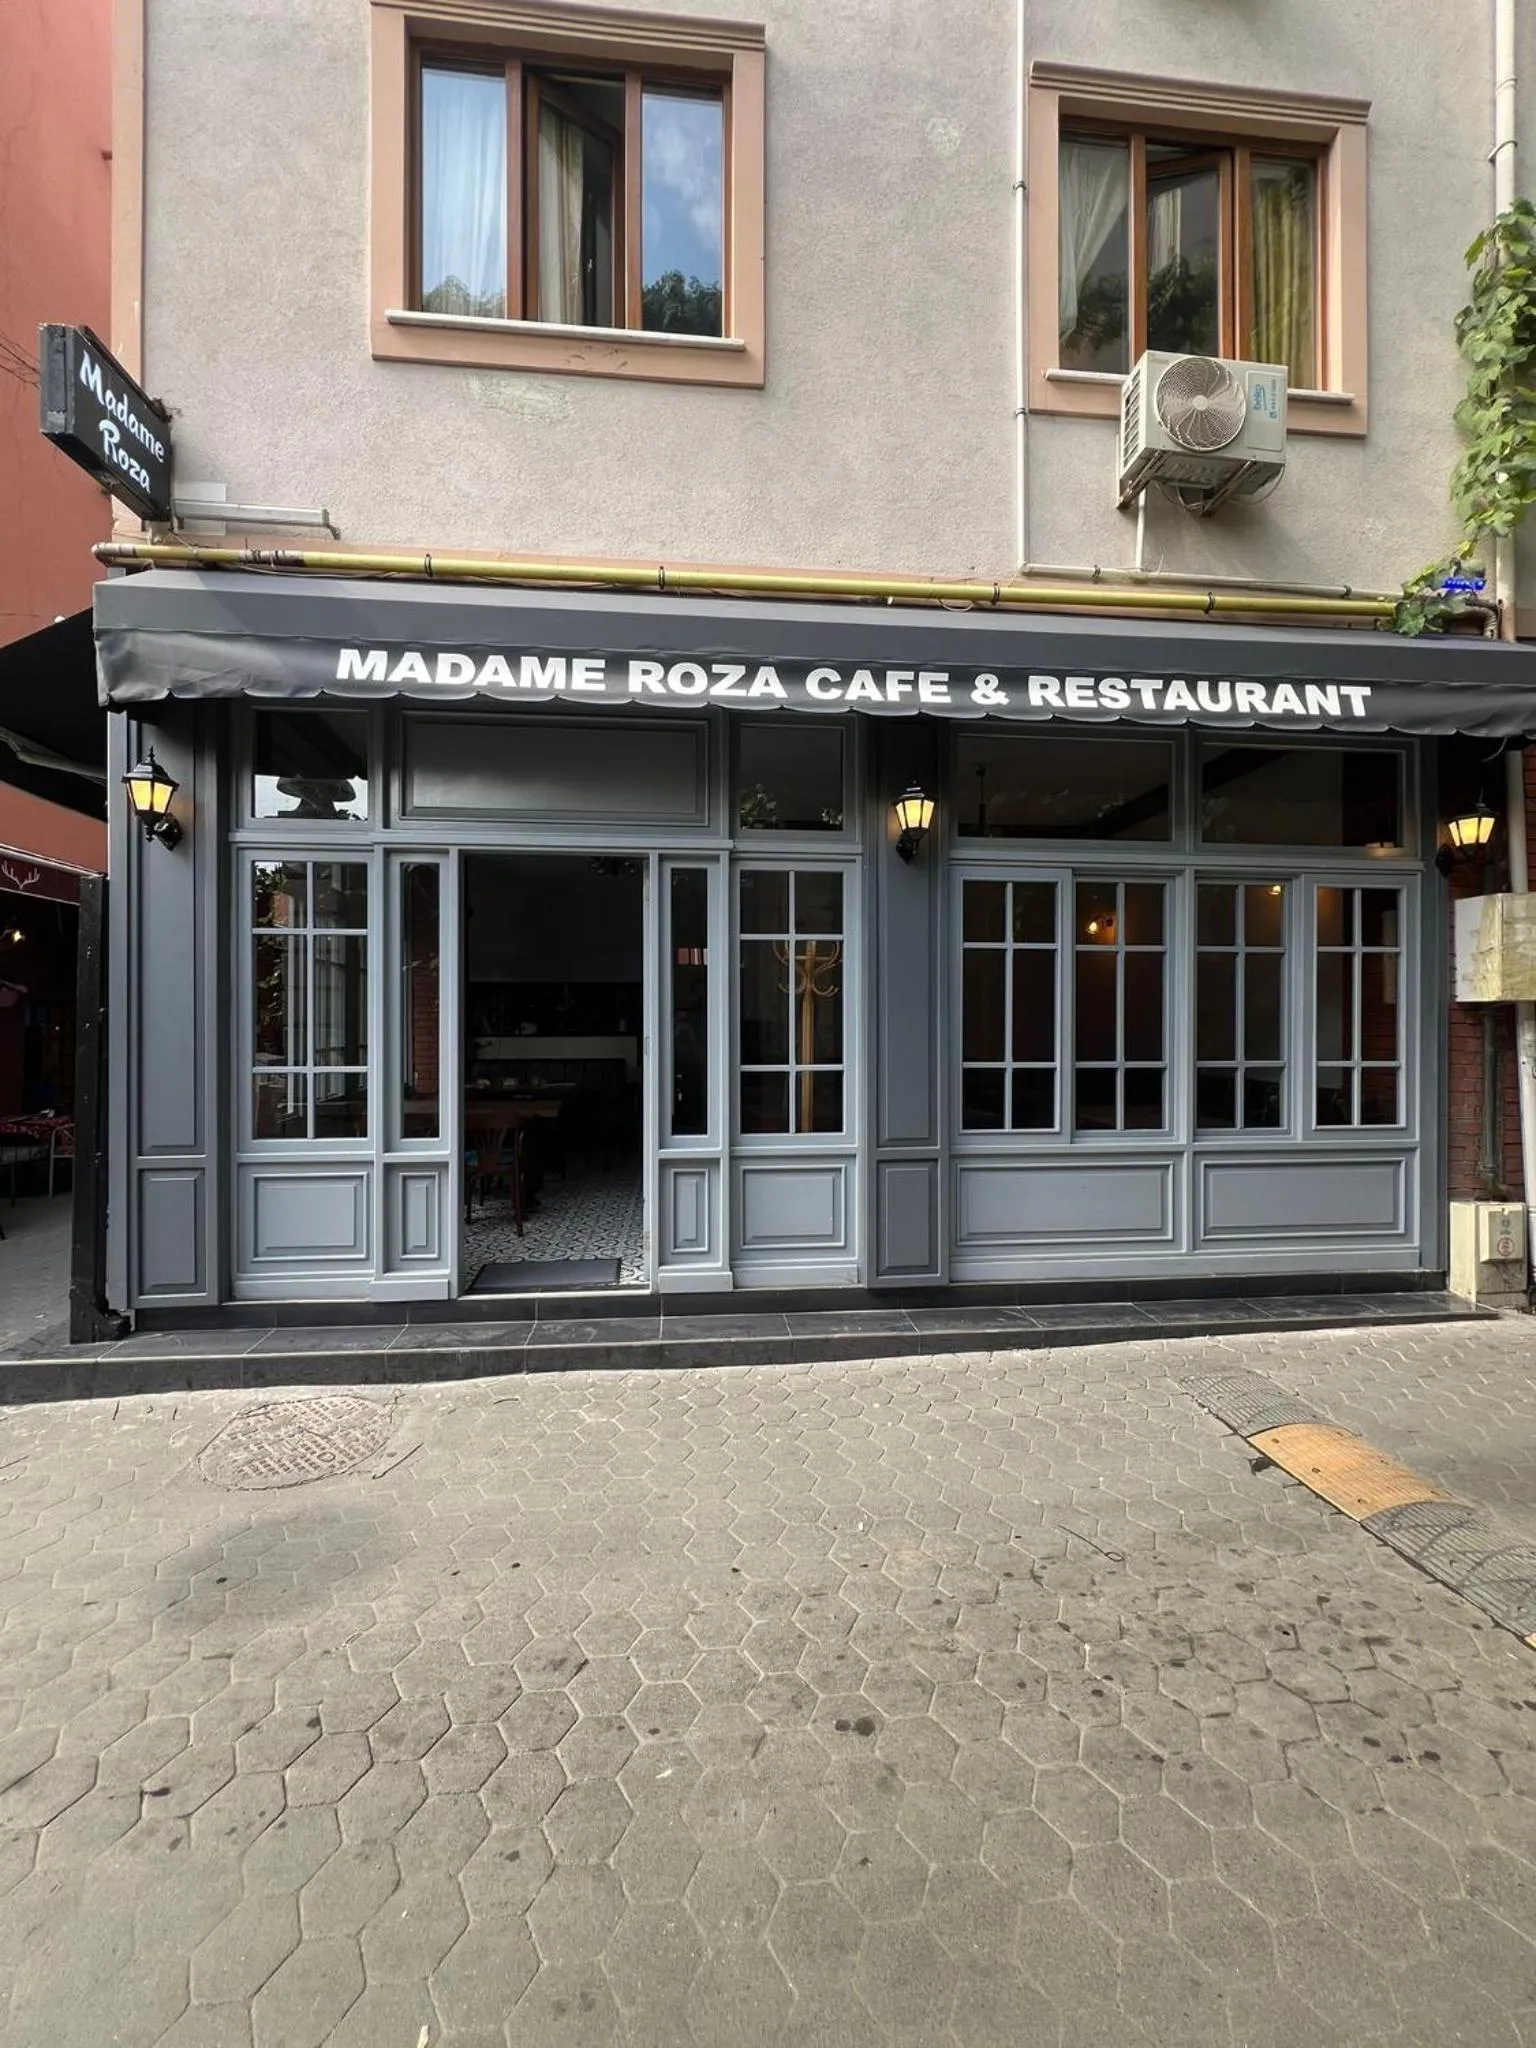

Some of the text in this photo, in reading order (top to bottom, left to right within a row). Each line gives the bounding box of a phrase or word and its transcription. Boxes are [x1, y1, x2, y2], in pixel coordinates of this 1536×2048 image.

[80, 349, 164, 463] Madame
[99, 419, 150, 494] Roza
[336, 649, 1372, 717] MADAME ROZA CAFE & RESTAURANT
